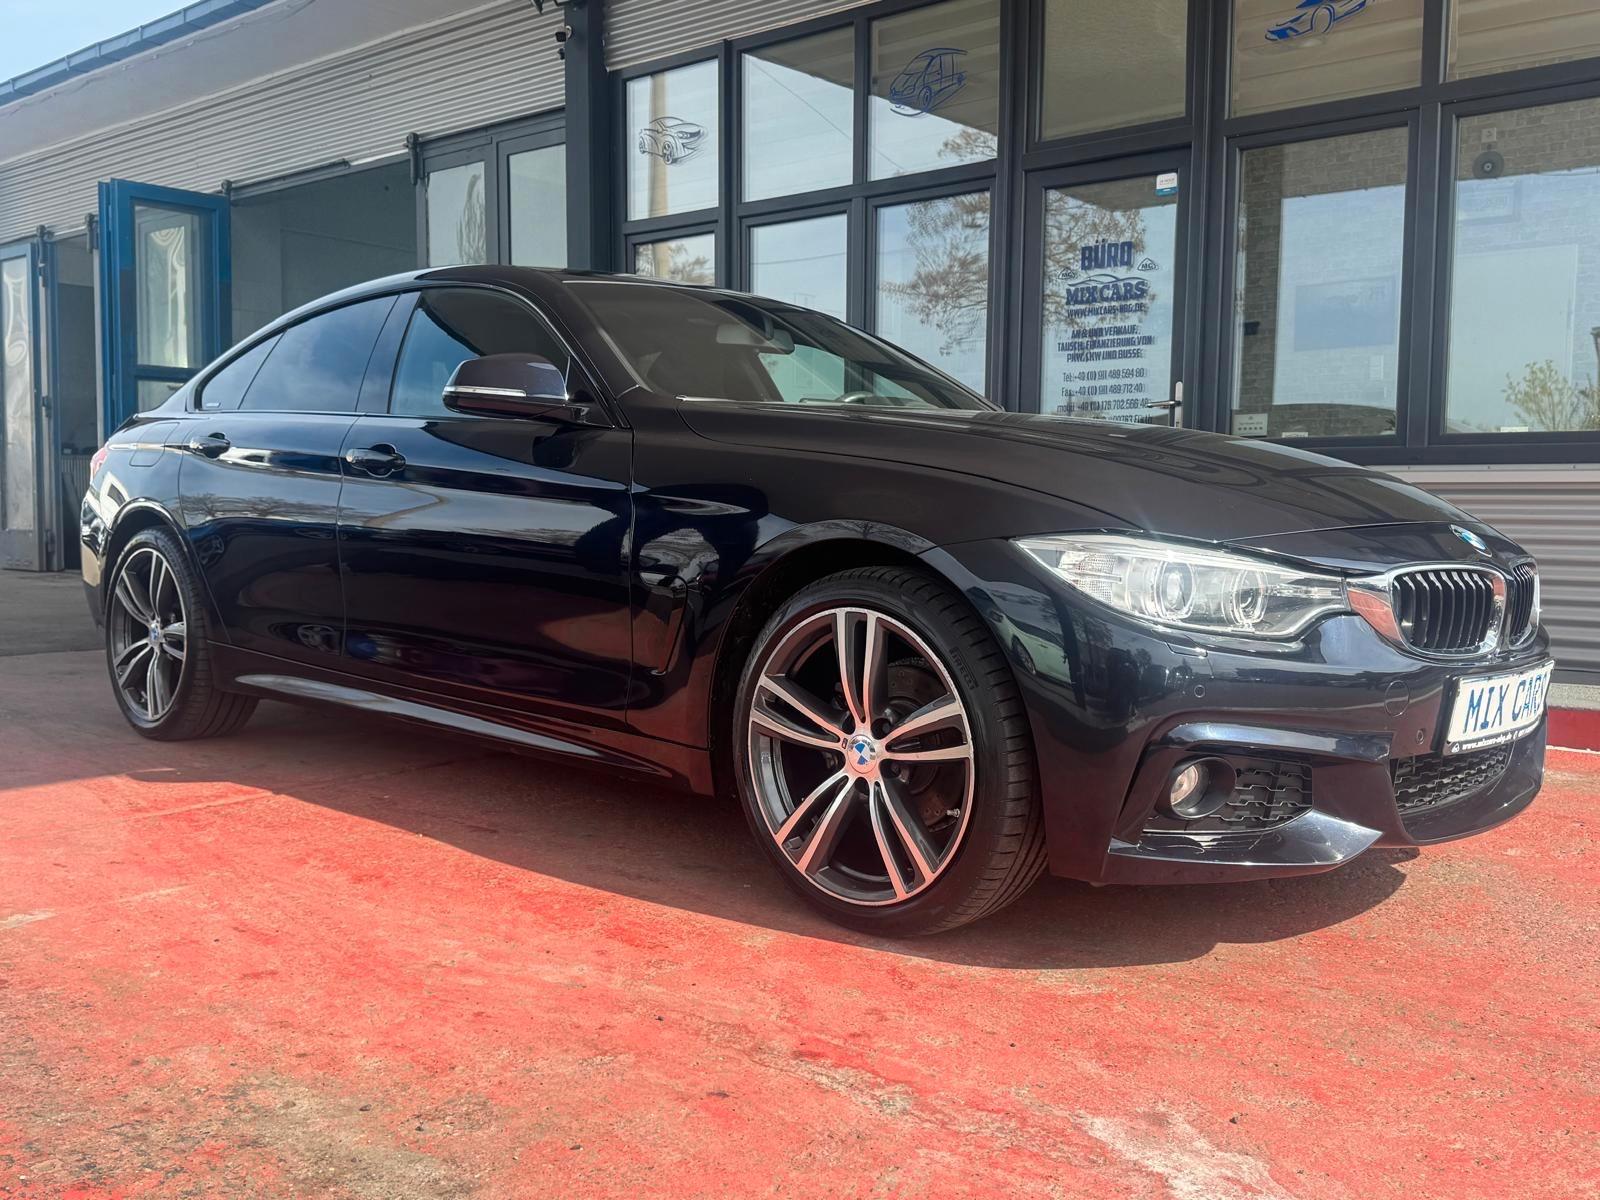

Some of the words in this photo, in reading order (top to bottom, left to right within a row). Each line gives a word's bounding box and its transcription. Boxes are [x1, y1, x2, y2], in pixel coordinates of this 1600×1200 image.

[1081, 239, 1133, 270] BÜRO
[1065, 286, 1097, 305] MIX
[1100, 281, 1146, 302] CARS
[1463, 683, 1510, 734] MIX
